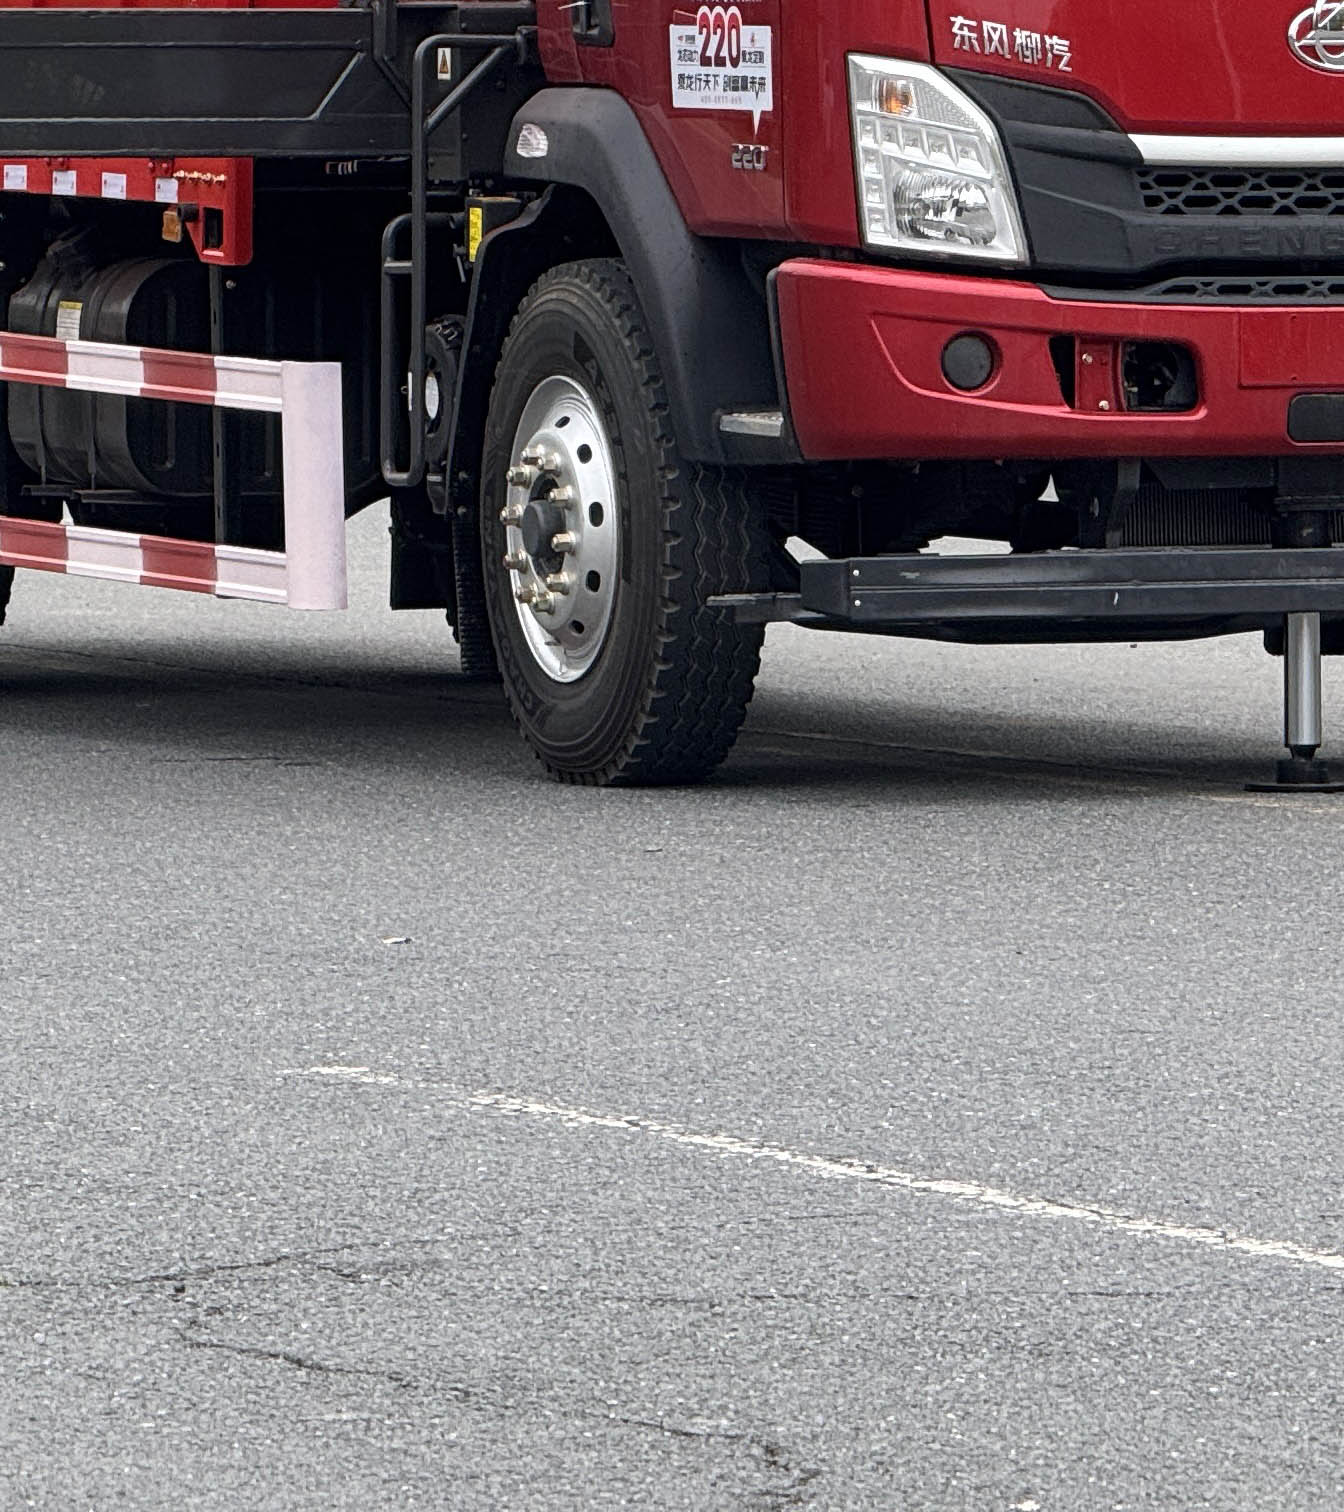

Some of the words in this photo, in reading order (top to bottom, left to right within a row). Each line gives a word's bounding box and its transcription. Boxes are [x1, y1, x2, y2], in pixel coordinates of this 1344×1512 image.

[697, 10, 742, 69] 220
[949, 15, 1073, 73] 东风柳汽
